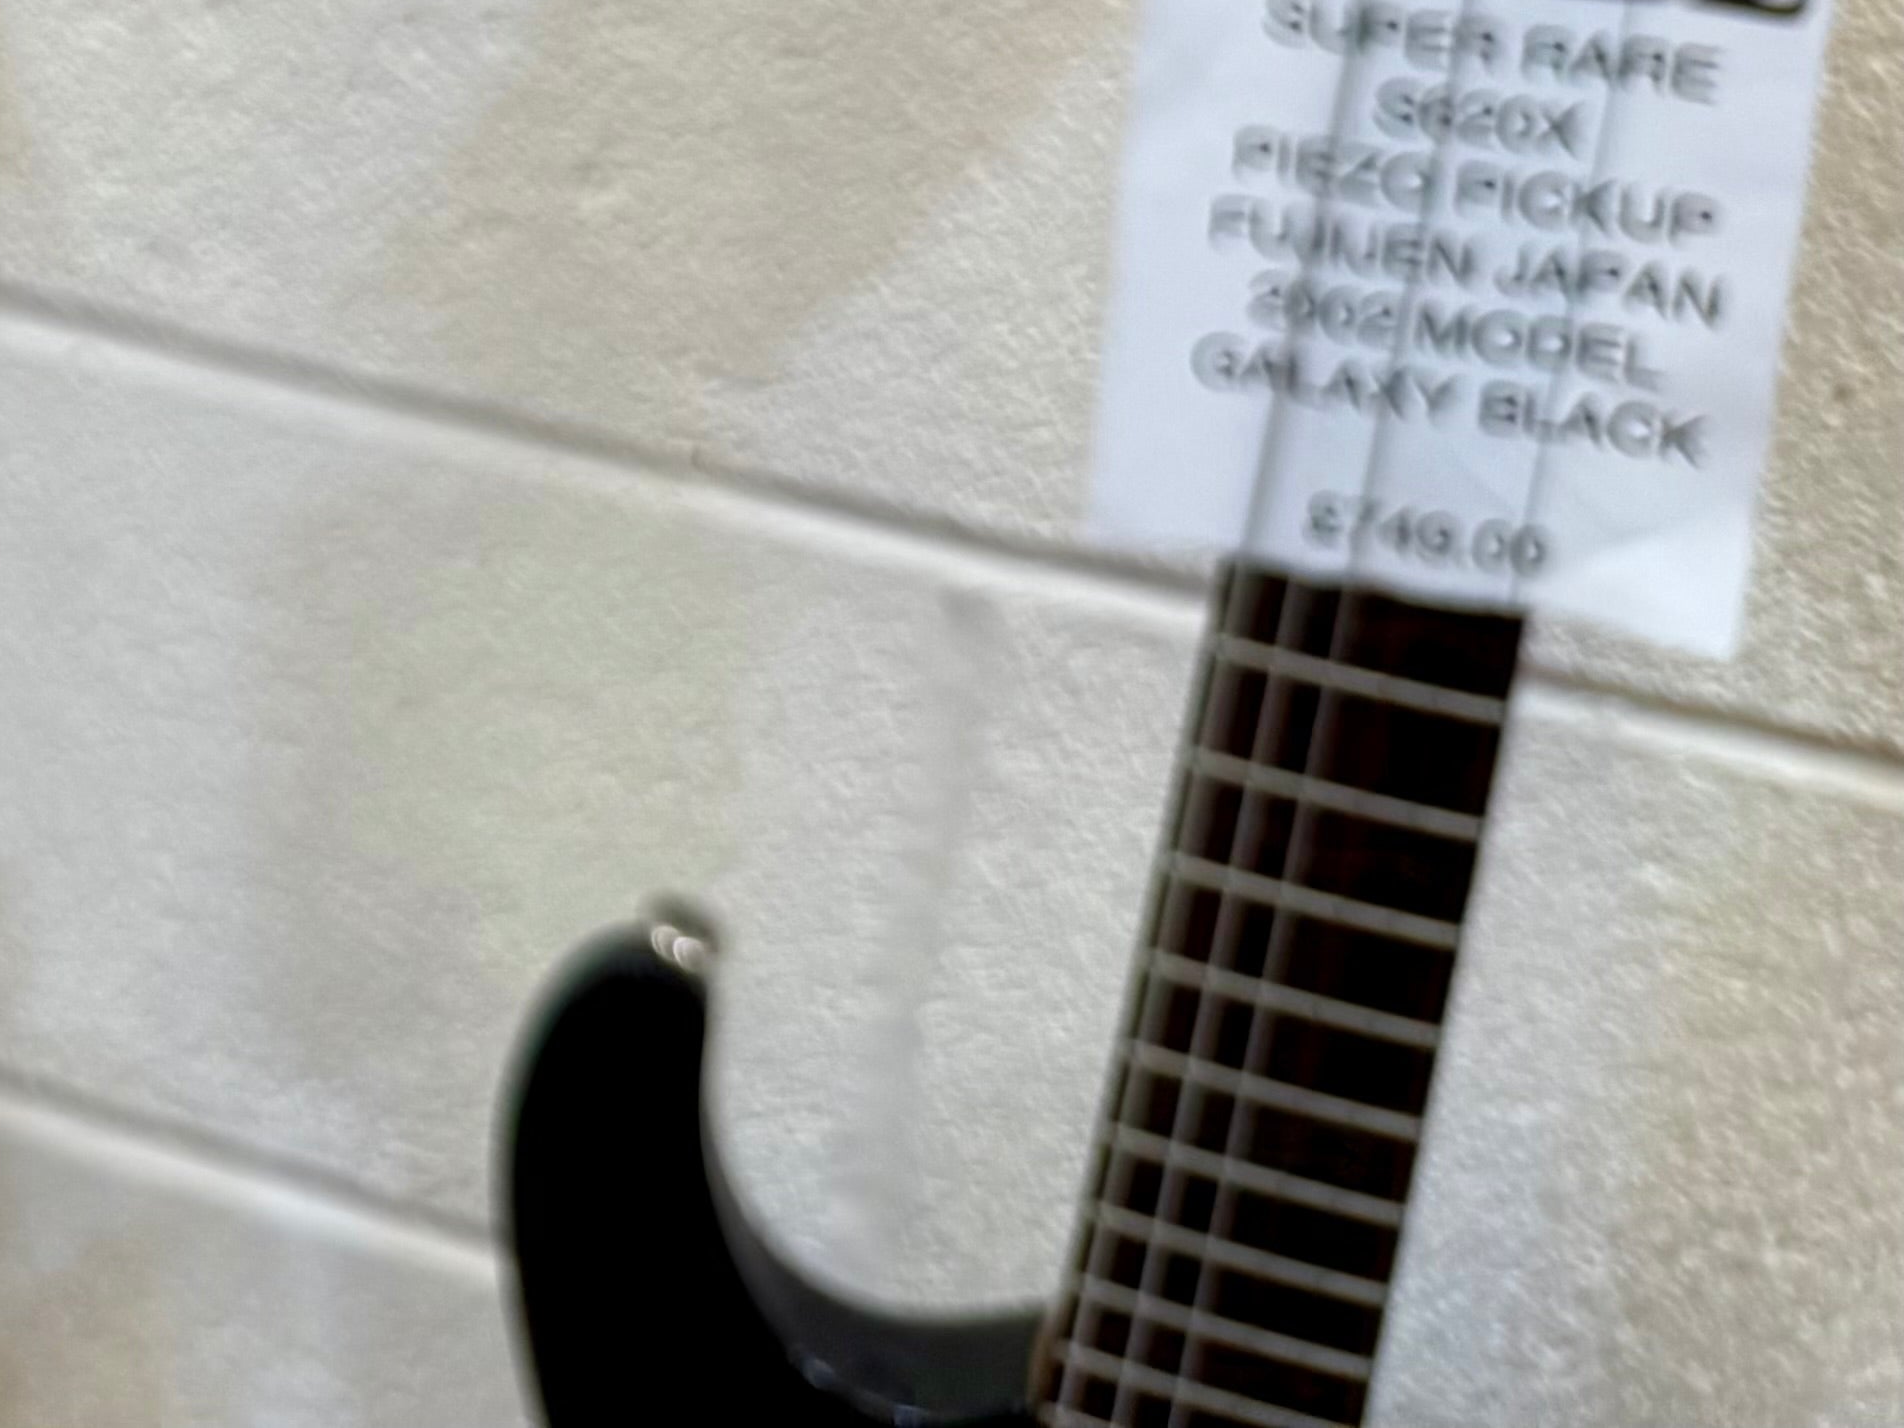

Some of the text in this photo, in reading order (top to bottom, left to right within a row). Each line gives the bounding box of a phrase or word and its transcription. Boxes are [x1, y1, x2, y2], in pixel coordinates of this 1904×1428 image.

[1521, 24, 1723, 106] RARE
[1232, 124, 1723, 246] PIEZO PICKUP
[1247, 268, 1668, 392] 2002 MODEL
[1492, 245, 1728, 331] JAPAN
[1190, 330, 1708, 469] GALAXY BLACK
